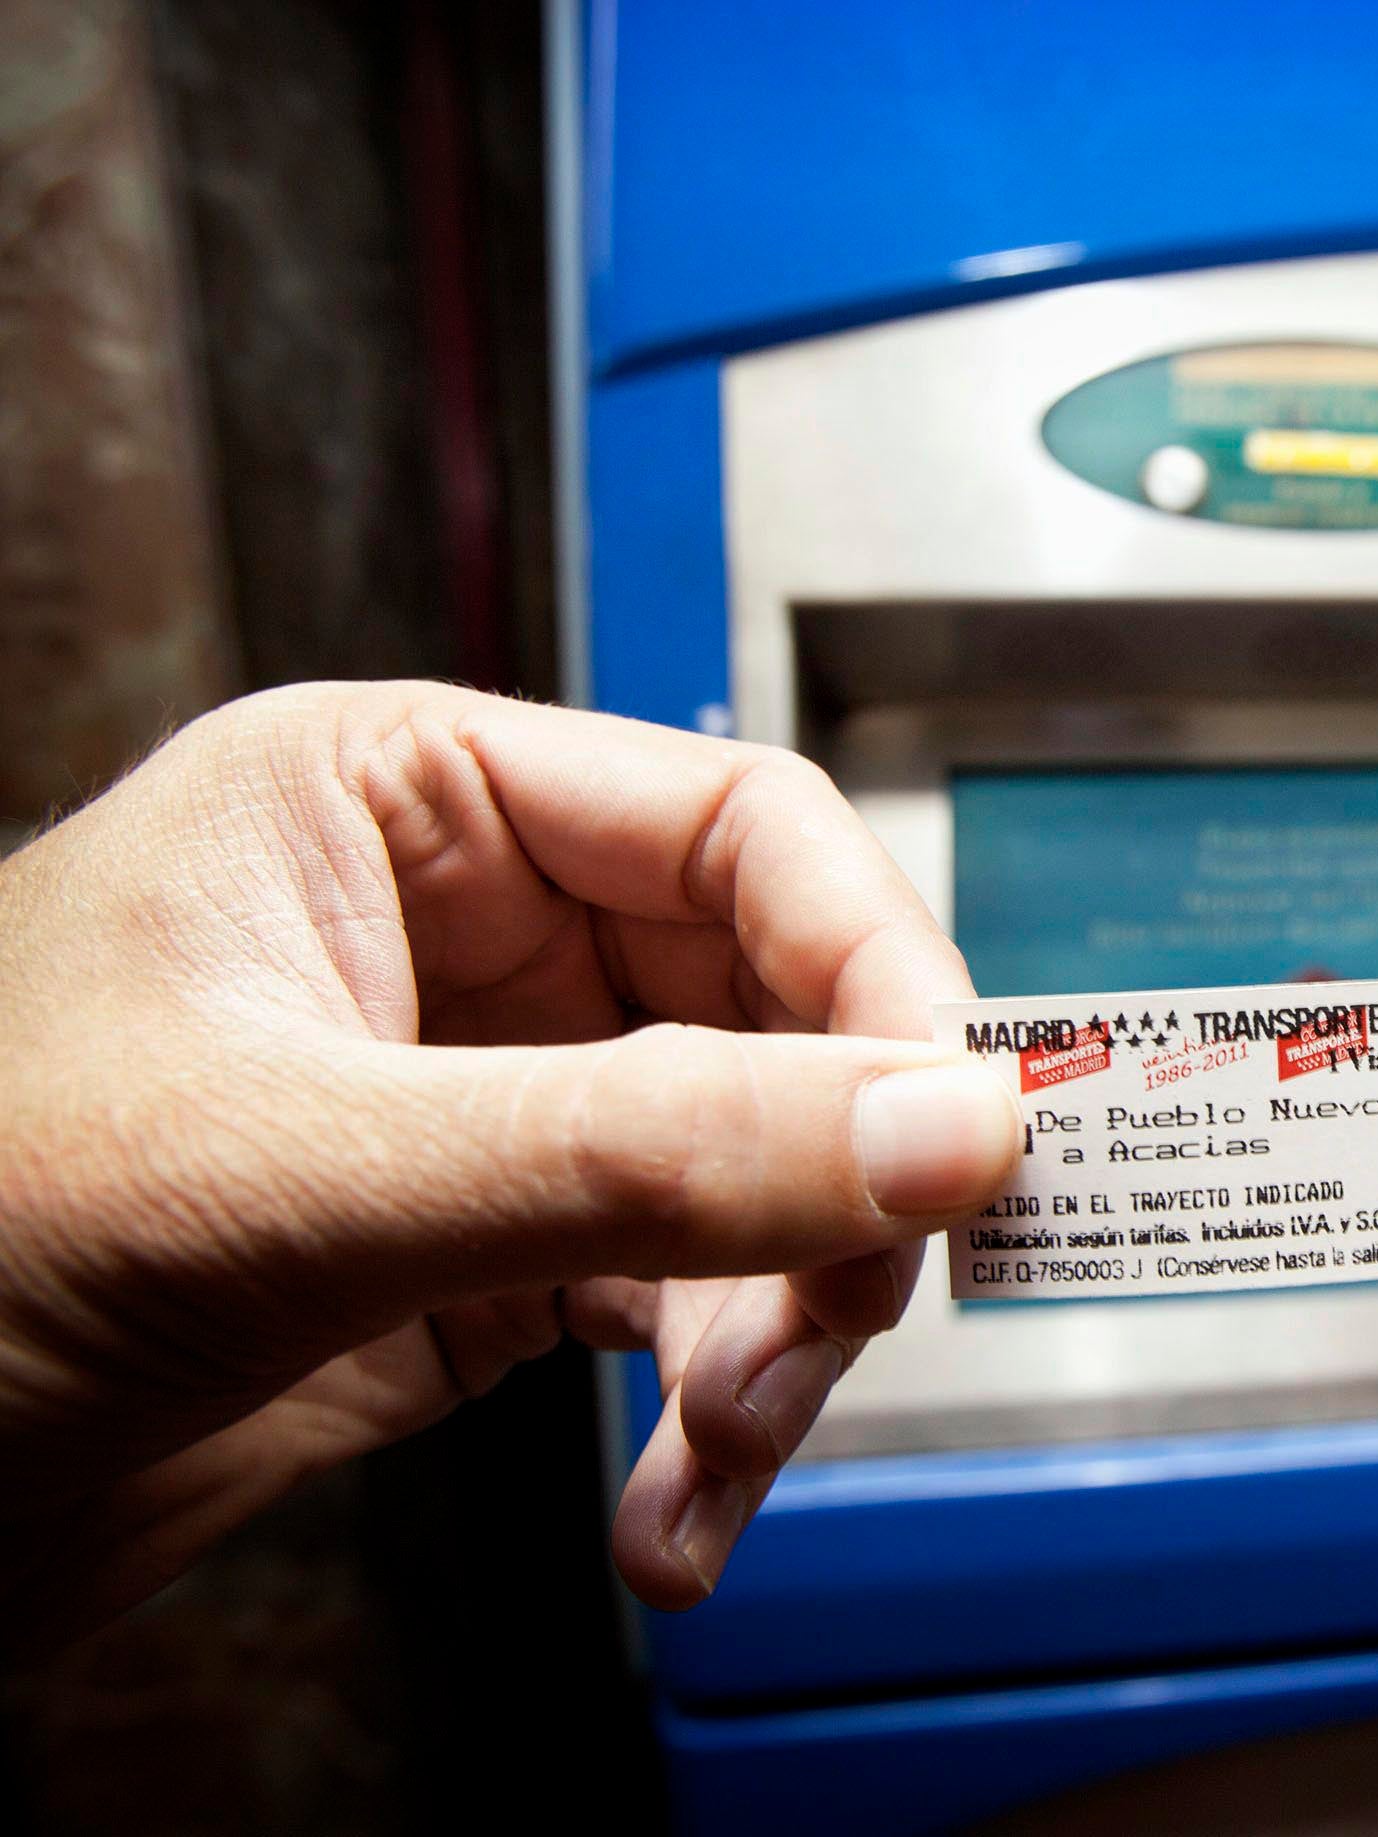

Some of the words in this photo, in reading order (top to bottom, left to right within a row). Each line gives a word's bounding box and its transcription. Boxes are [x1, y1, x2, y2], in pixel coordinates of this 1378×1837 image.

[965, 1018, 1077, 1054] MADRID
[1028, 1041, 1106, 1075] TRANSPORTES
[1063, 1055, 1107, 1079] MADRID
[1144, 1041, 1250, 1092] 1986-2011
[1035, 1110, 1082, 1134] De
[1106, 1103, 1246, 1131] Pueblo
[1062, 1147, 1084, 1164] a
[1107, 1135, 1271, 1163] Acacias
[1053, 1195, 1079, 1217] EN
[1090, 1193, 1116, 1215] EL
[1129, 1187, 1231, 1213] TRAYECTO
[1244, 1180, 1344, 1206] INDICADO
[1066, 1225, 1124, 1249] según
[1201, 1217, 1285, 1243] Incluidos
[1340, 1217, 1351, 1235] y
[1015, 1259, 1125, 1283] Q-7850003
[1157, 1254, 1271, 1279] (Consérvese
[1275, 1250, 1326, 1271] hasta
[1331, 1246, 1345, 1266] la
